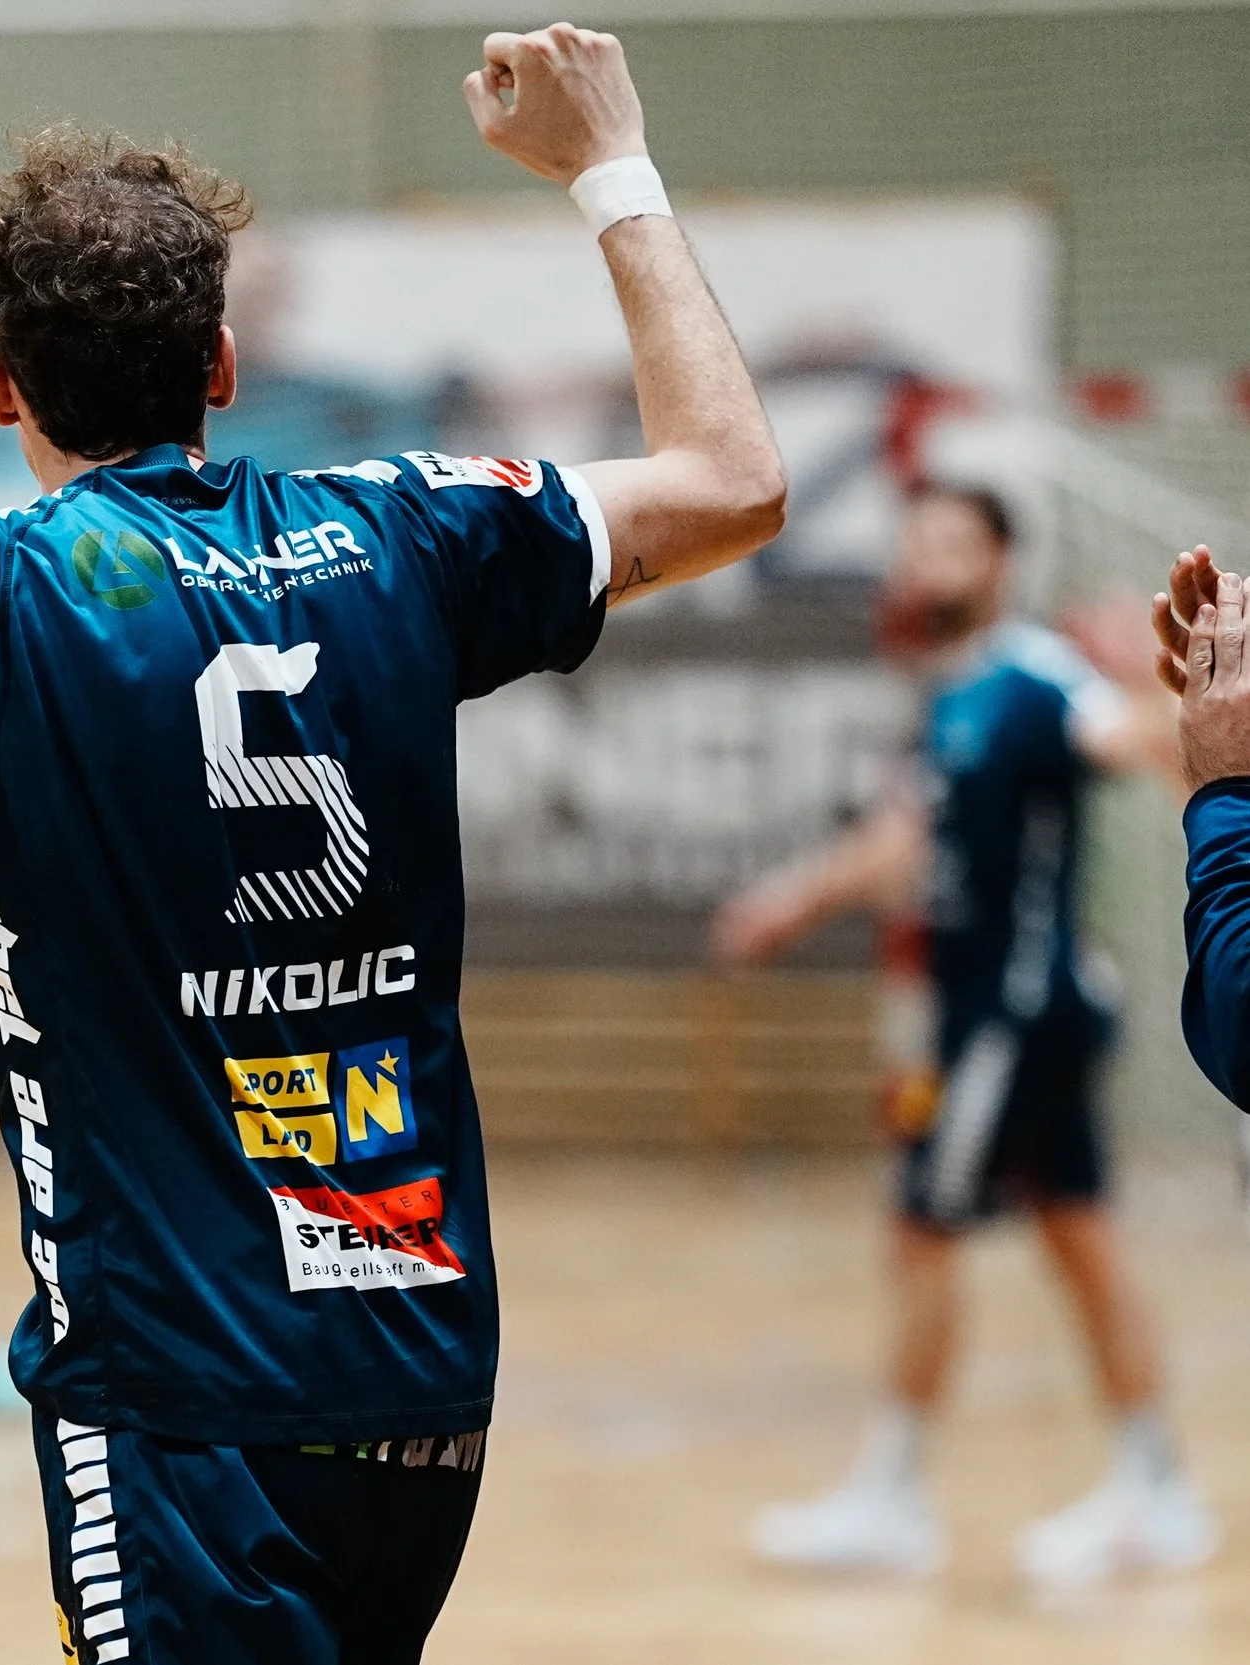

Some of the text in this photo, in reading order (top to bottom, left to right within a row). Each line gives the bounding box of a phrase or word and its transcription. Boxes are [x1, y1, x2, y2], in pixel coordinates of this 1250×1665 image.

[195, 642, 369, 923] 5
[181, 944, 415, 1017] NIKOLIC
[10, 1070, 53, 1218] are
[346, 1065, 405, 1143] N
